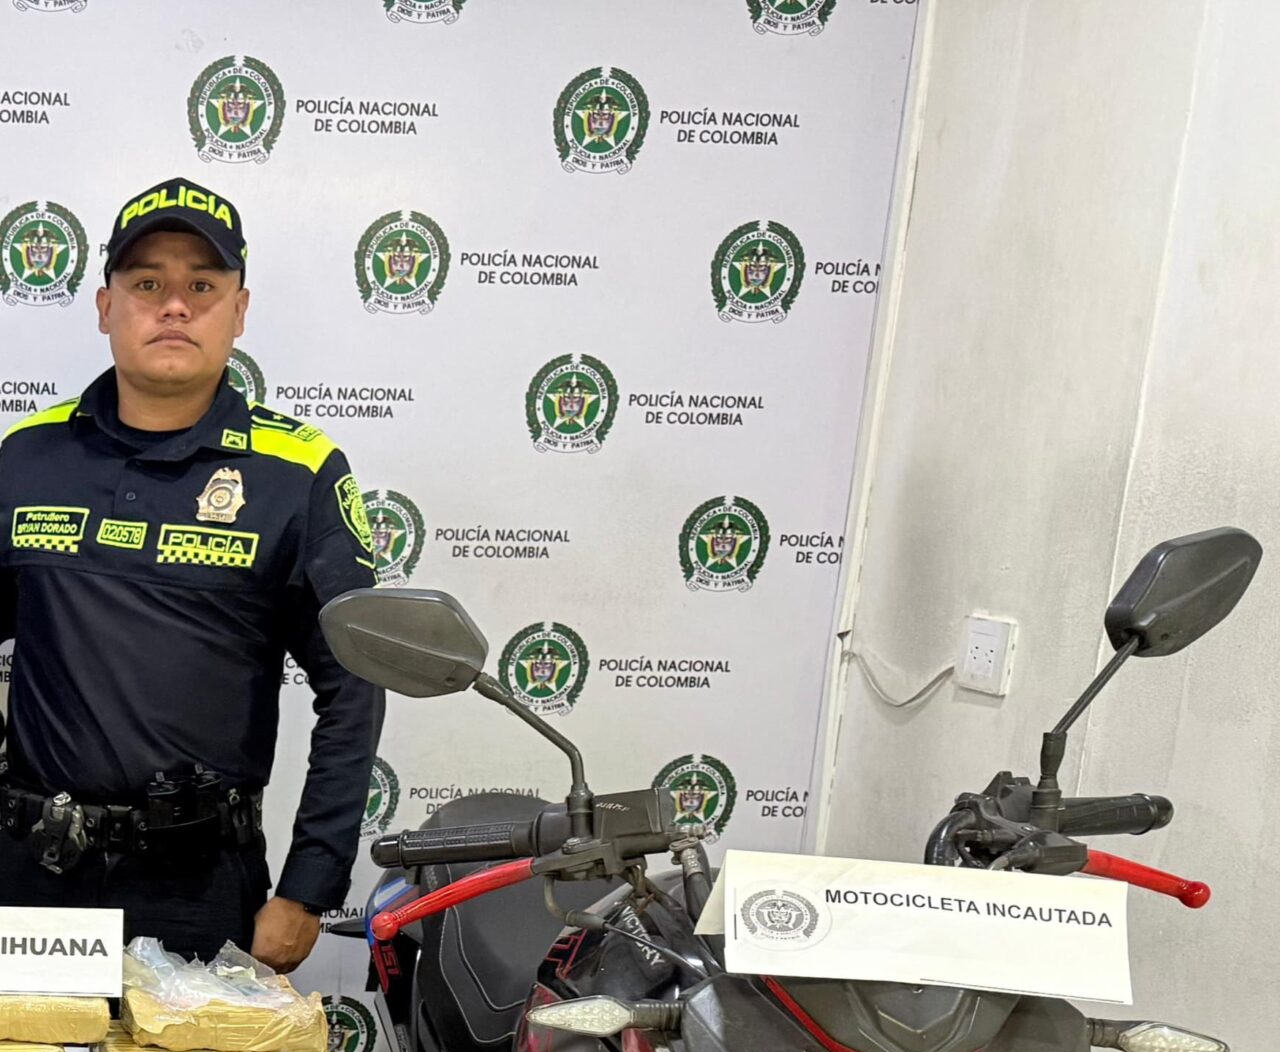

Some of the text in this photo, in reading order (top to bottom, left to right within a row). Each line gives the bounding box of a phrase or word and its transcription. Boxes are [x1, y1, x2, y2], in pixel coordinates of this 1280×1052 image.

[296, 97, 438, 117] POLICÍA NACIONAL
[616, 82, 638, 117] COLOMBIA
[660, 108, 799, 127] POLICÍA NACIONAL
[314, 119, 417, 135] DE COLOMBIA
[677, 130, 778, 145] DE COLOMBIA
[599, 140, 630, 160] NACIONAL
[461, 250, 599, 269] POLICÍA NACIONAL
[815, 259, 870, 276] POLICÍA
[478, 271, 578, 286] DE COLOMBIA
[832, 280, 850, 293] DE
[276, 383, 414, 401] POLICÍA NACIONAL
[629, 391, 764, 409] POLICÍA NACIONAL
[294, 404, 393, 418] DE COLOMBIA
[645, 411, 743, 425] DE COLOMBIA
[41, 523, 77, 534] DORADO
[102, 525, 141, 543] 020578
[435, 529, 570, 542] POLICÍA NACIONAL
[170, 535, 245, 554] POLICÍA
[780, 532, 832, 547] POLICÍA
[452, 545, 549, 558] DE COLOMBIA
[796, 551, 813, 563] DE
[599, 656, 730, 672] POLICÍA NACIONAL
[615, 675, 710, 688] DE COLOMBIA
[746, 787, 799, 802] POLICÍA
[762, 806, 778, 817] DE
[826, 889, 1112, 927] MOTOCICLETA INCAUTADA
